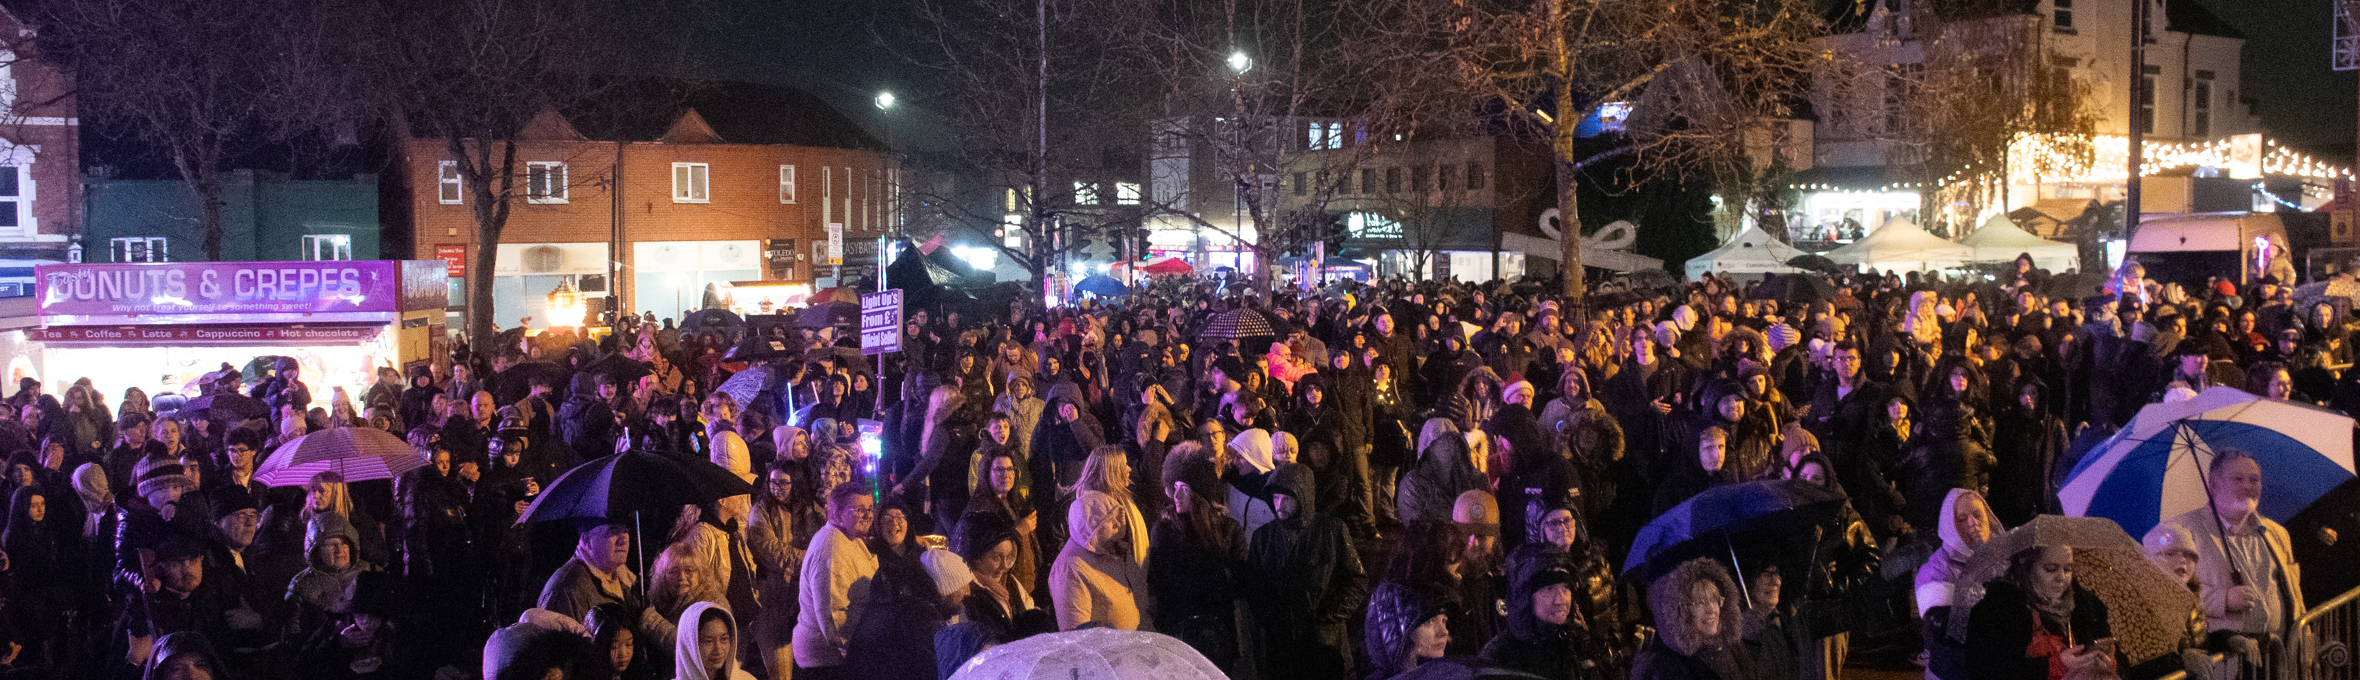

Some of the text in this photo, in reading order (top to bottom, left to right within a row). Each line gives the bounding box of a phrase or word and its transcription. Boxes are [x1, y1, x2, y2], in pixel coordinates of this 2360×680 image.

[770, 249, 795, 257] TOLEDO
[46, 269, 92, 287] Tasty
[52, 268, 361, 299] DONUTS & CREPES
[112, 304, 132, 313] Why
[134, 304, 150, 312] not
[153, 303, 176, 312] treat
[178, 303, 216, 313] yourself
[227, 302, 279, 313] something
[280, 302, 312, 311] sweet!
[862, 292, 898, 309] Light Up's
[862, 313, 883, 328] From
[41, 329, 359, 339] Tea Coffee Latte Cappuccino Hot chocolate
[880, 330, 897, 347] Seller
